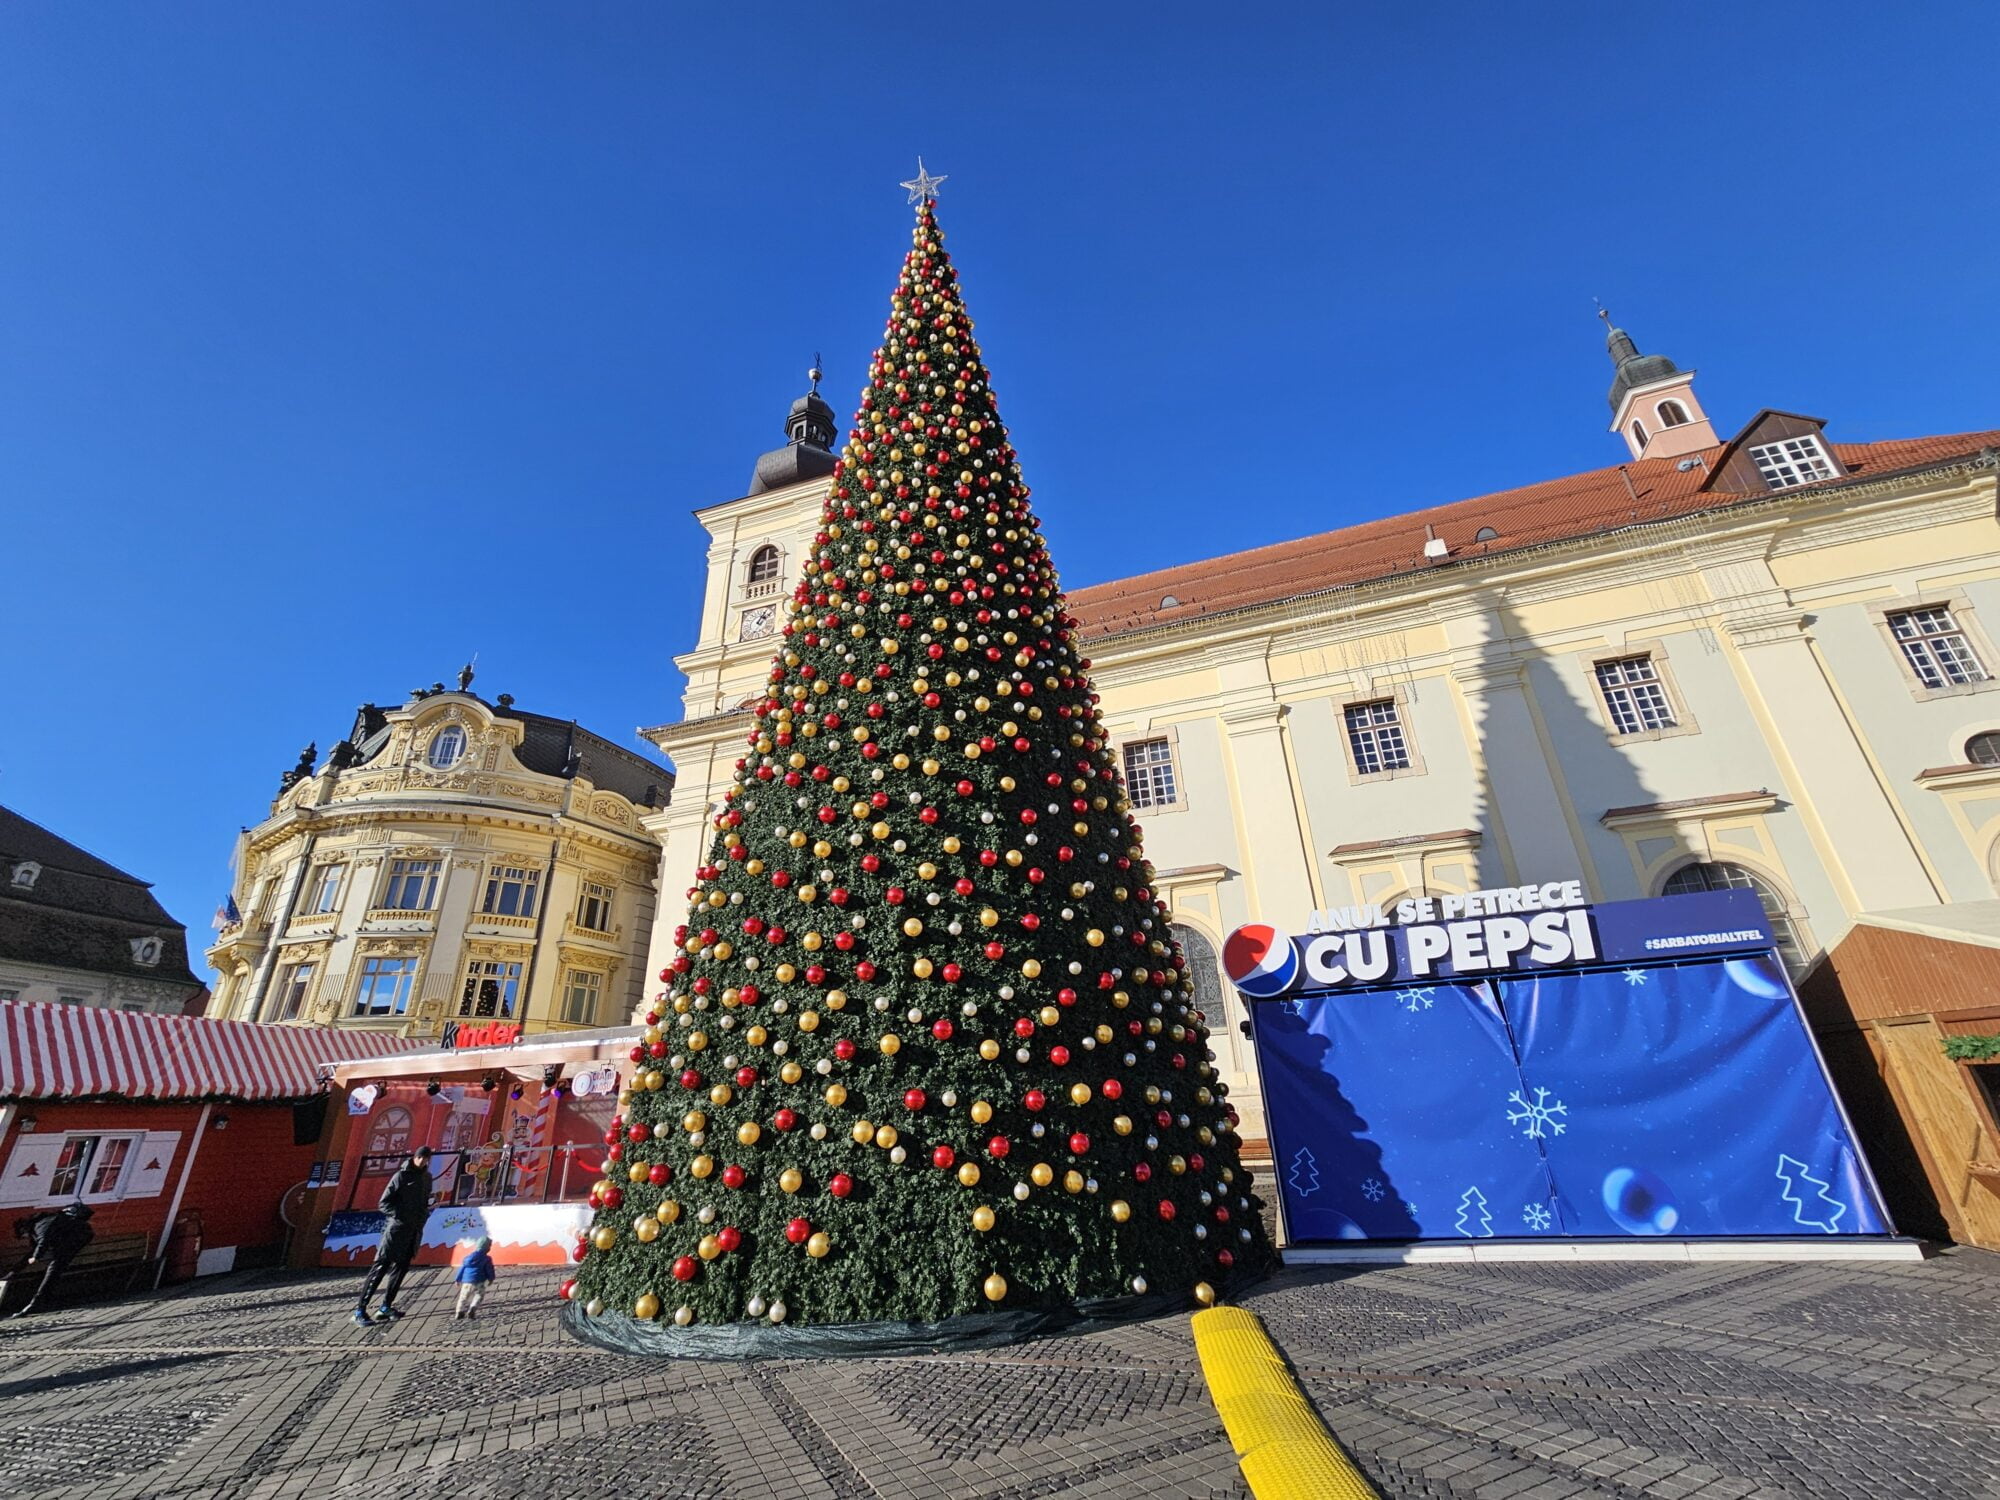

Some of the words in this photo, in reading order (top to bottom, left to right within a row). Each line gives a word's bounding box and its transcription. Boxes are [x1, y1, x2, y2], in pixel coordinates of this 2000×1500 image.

[1306, 903, 1390, 935] ANUL
[1397, 897, 1438, 924] SE
[1441, 880, 1585, 920] PETRECE
[1304, 930, 1390, 984] CU
[1406, 909, 1596, 976] PEPSI
[1645, 929, 1764, 950] #SARBATORIALTFEL
[441, 1020, 523, 1049] Kinder
